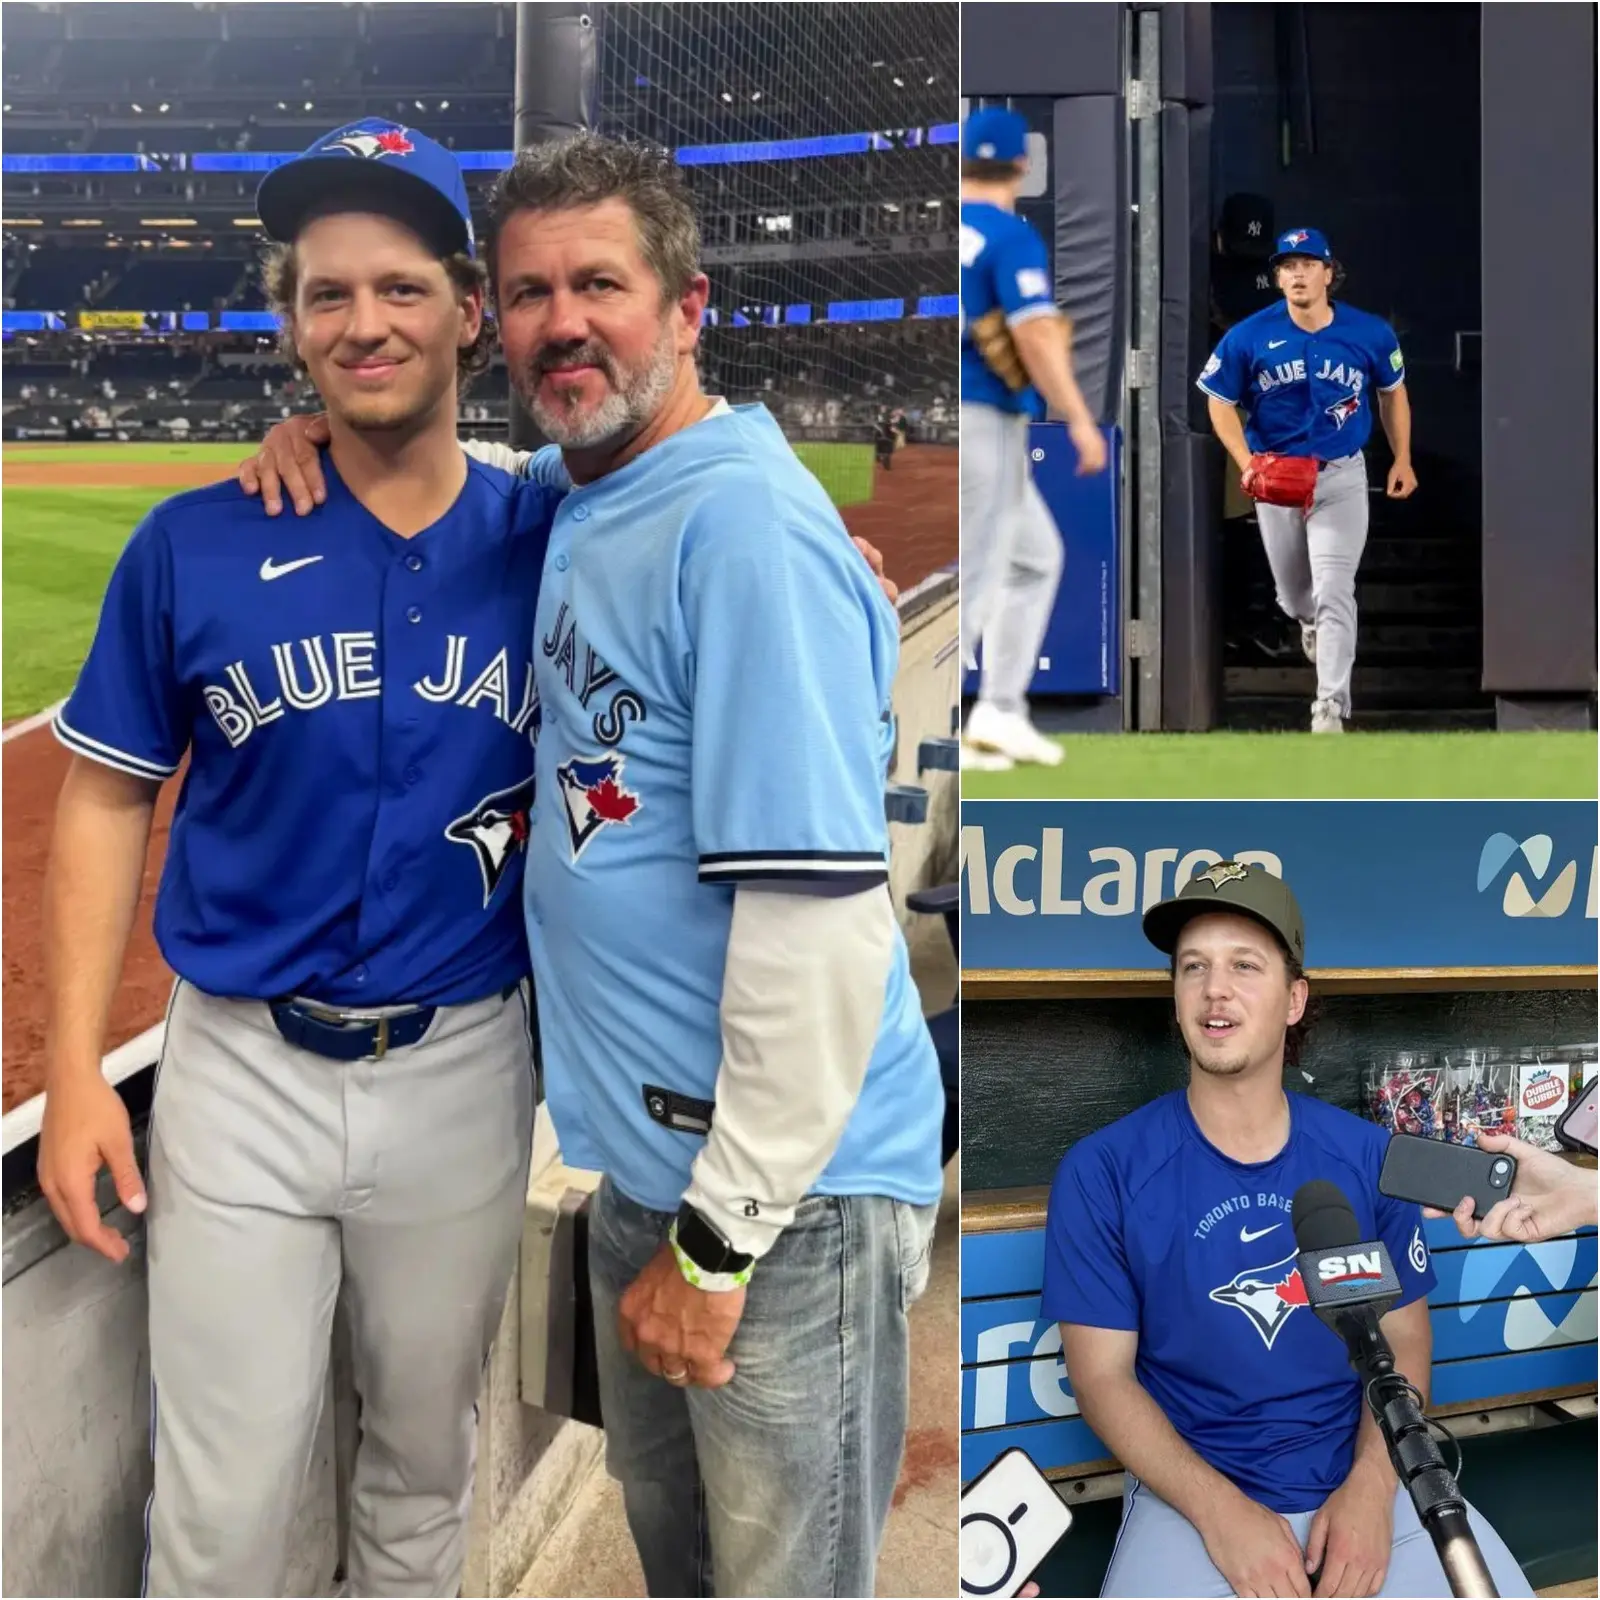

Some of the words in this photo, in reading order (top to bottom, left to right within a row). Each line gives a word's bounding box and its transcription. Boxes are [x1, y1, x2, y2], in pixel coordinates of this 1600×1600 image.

[1258, 359, 1307, 391] BLUE
[1315, 359, 1364, 392] JAYS
[203, 631, 381, 748] BLUE
[413, 634, 541, 748] JAY
[542, 601, 648, 747] JAYS
[1525, 1078, 1561, 1098] DUBBLE
[1527, 1086, 1563, 1107] BUBBLE
[1193, 1194, 1250, 1240] TORONTO
[1318, 1250, 1382, 1280] SN
[1408, 1224, 1430, 1273] 6
